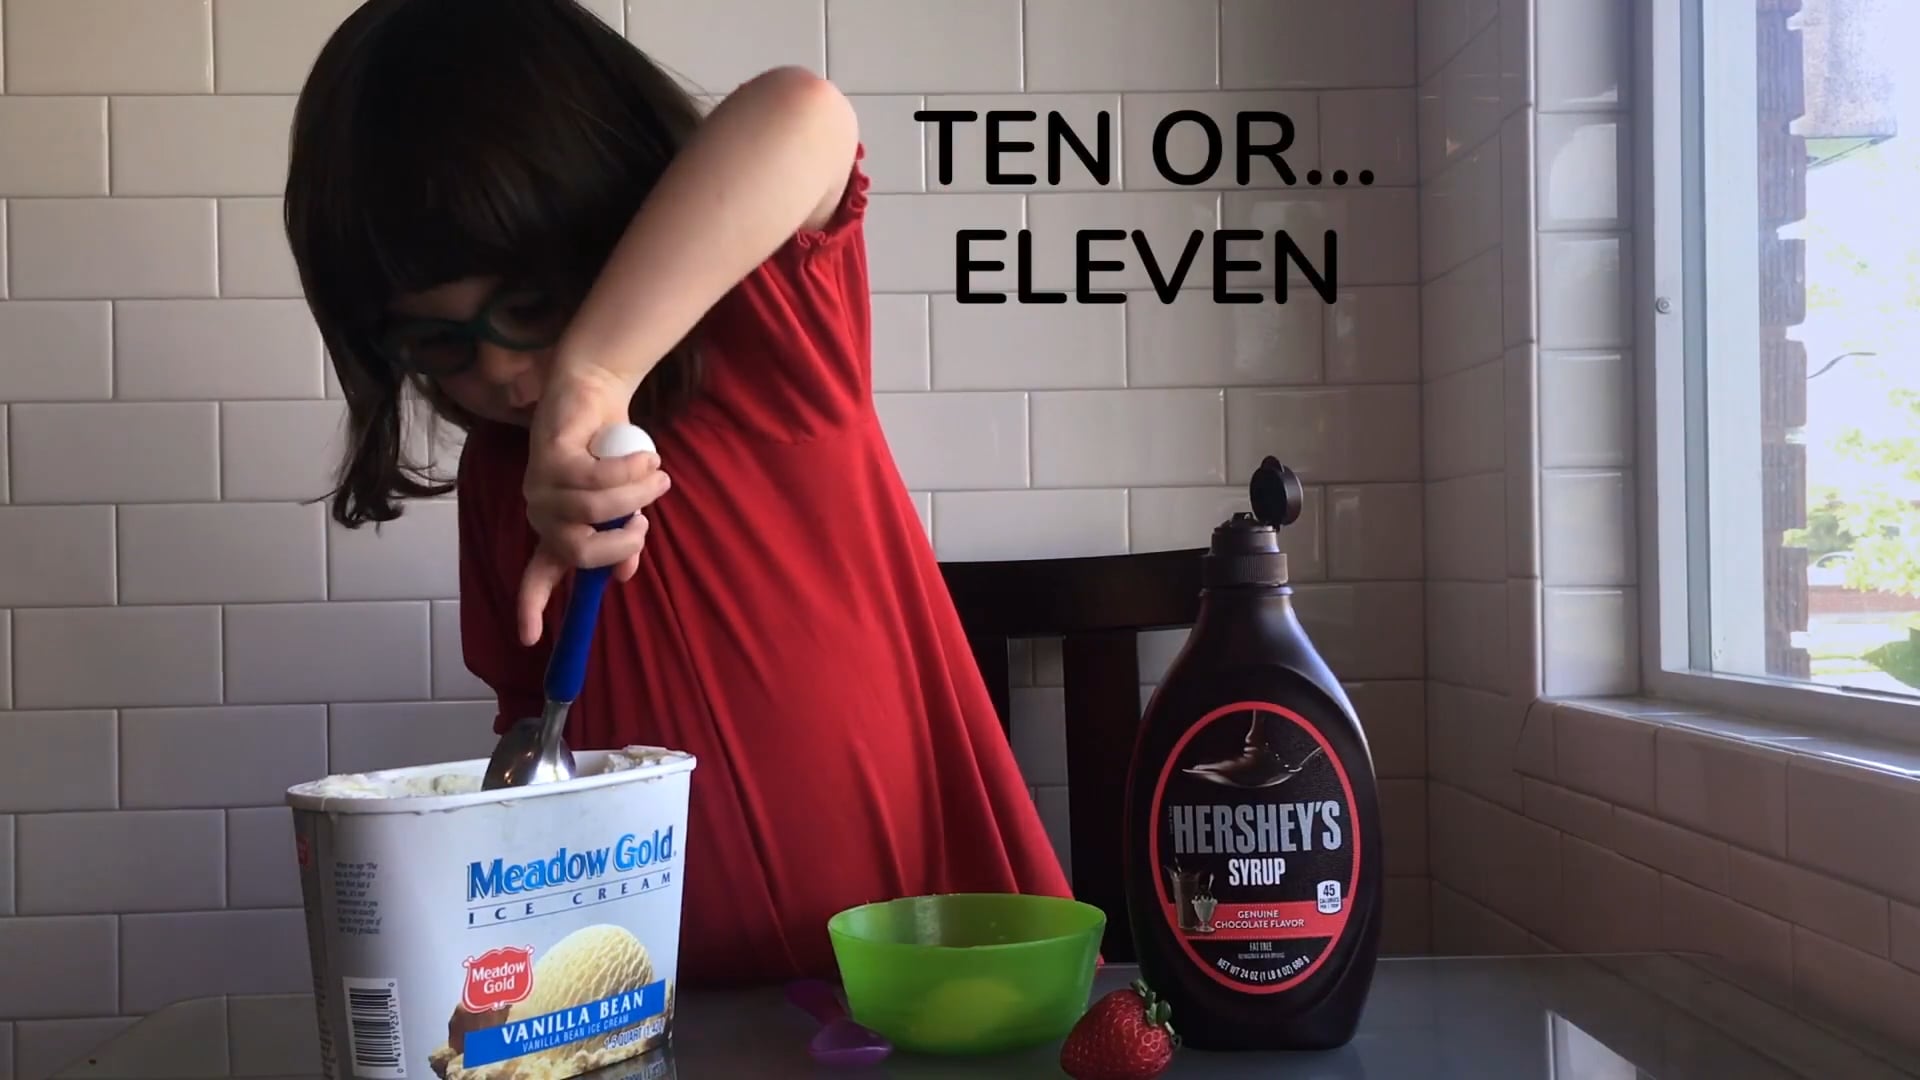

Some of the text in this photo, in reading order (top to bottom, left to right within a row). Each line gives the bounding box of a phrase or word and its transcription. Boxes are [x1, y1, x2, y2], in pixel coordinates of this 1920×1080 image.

[1173, 800, 1342, 854] HERSHEY'S
[466, 824, 674, 902] Meadow Gold
[1228, 858, 1286, 886] SYRUP
[468, 871, 671, 925] ICE CREAM
[1323, 884, 1336, 897] 45
[1215, 918, 1305, 930] CHOCOLATE FLAVOR
[1237, 909, 1279, 919] GENUINE
[471, 960, 527, 983] Meadow
[1217, 957, 1231, 971] NET
[1229, 965, 1241, 976] WT
[1240, 968, 1249, 979] 24
[1249, 970, 1259, 981] OZ
[1267, 970, 1276, 980] LB
[1281, 964, 1294, 975] OZ)
[483, 975, 516, 994] Gold
[502, 989, 644, 1044] VANILLA BEAN
[522, 1014, 629, 1053] VANILLA BEAN ICE CREAM
[617, 1025, 643, 1046] QUART
